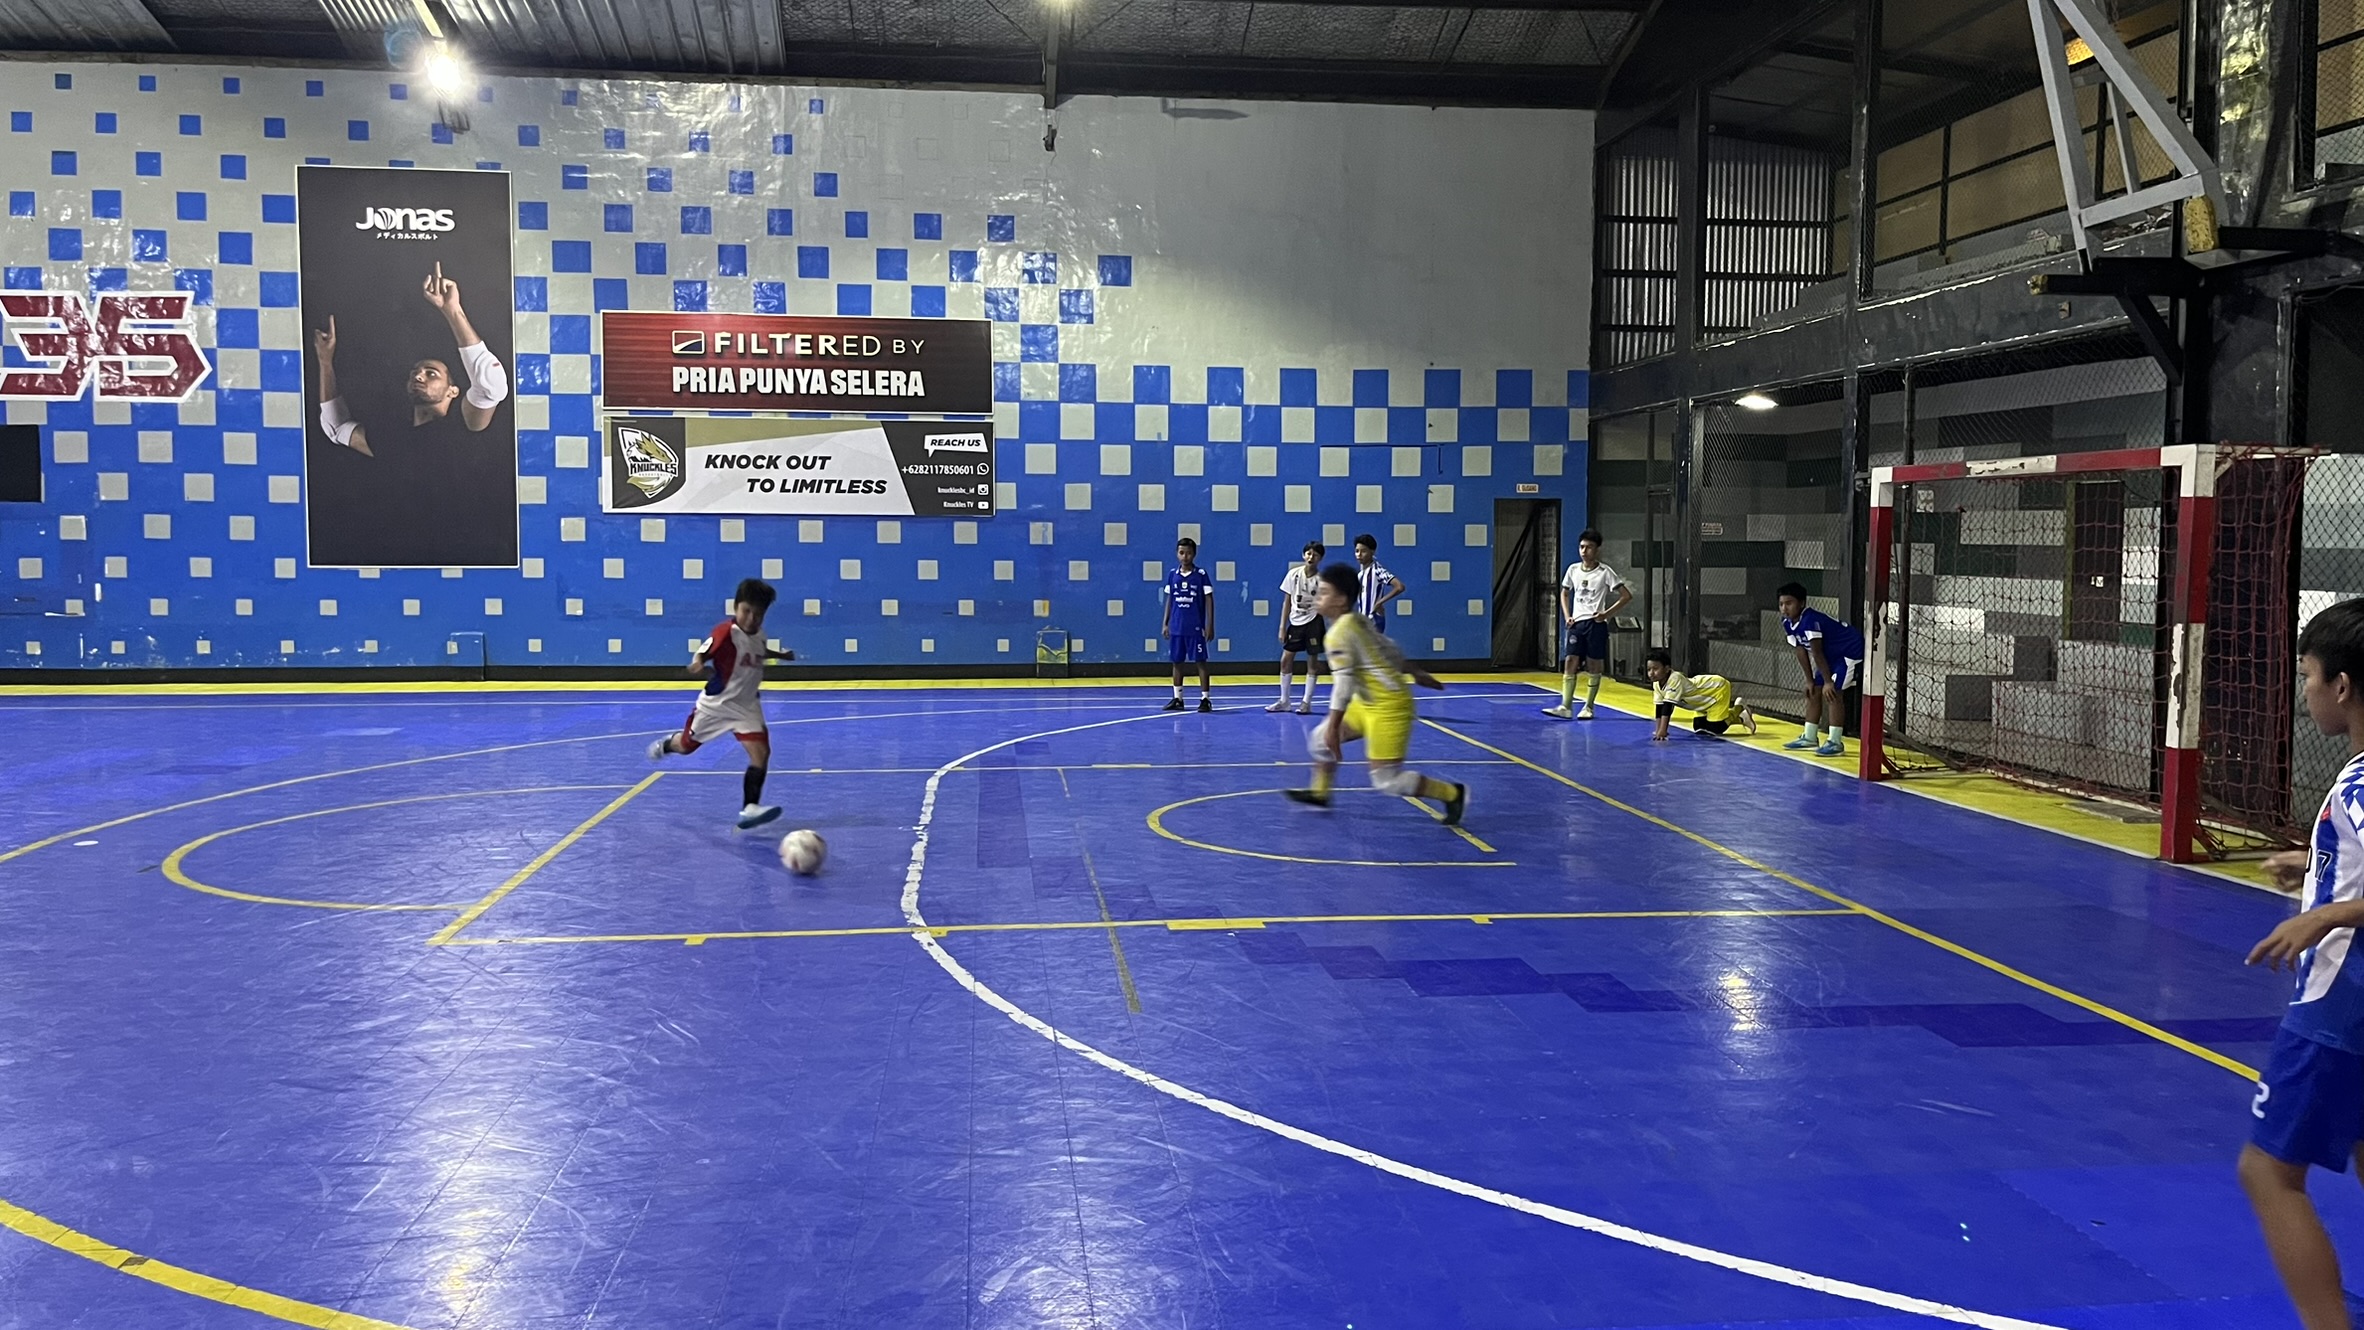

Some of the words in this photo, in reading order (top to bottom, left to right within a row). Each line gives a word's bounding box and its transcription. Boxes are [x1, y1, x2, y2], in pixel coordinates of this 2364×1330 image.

[714, 331, 881, 356] FILTERED
[892, 339, 925, 354] BY
[672, 366, 736, 393] PRIA
[739, 367, 828, 395] PUNYA
[830, 369, 925, 397] SELERA
[930, 439, 966, 447] REACH
[967, 439, 981, 447] US
[630, 463, 677, 476] KNUCKLES
[704, 454, 782, 469] KNOCK
[785, 455, 832, 470] OUT
[901, 464, 974, 475] +6282117850601
[747, 478, 775, 493] TO
[779, 479, 887, 494] LIMITLESS
